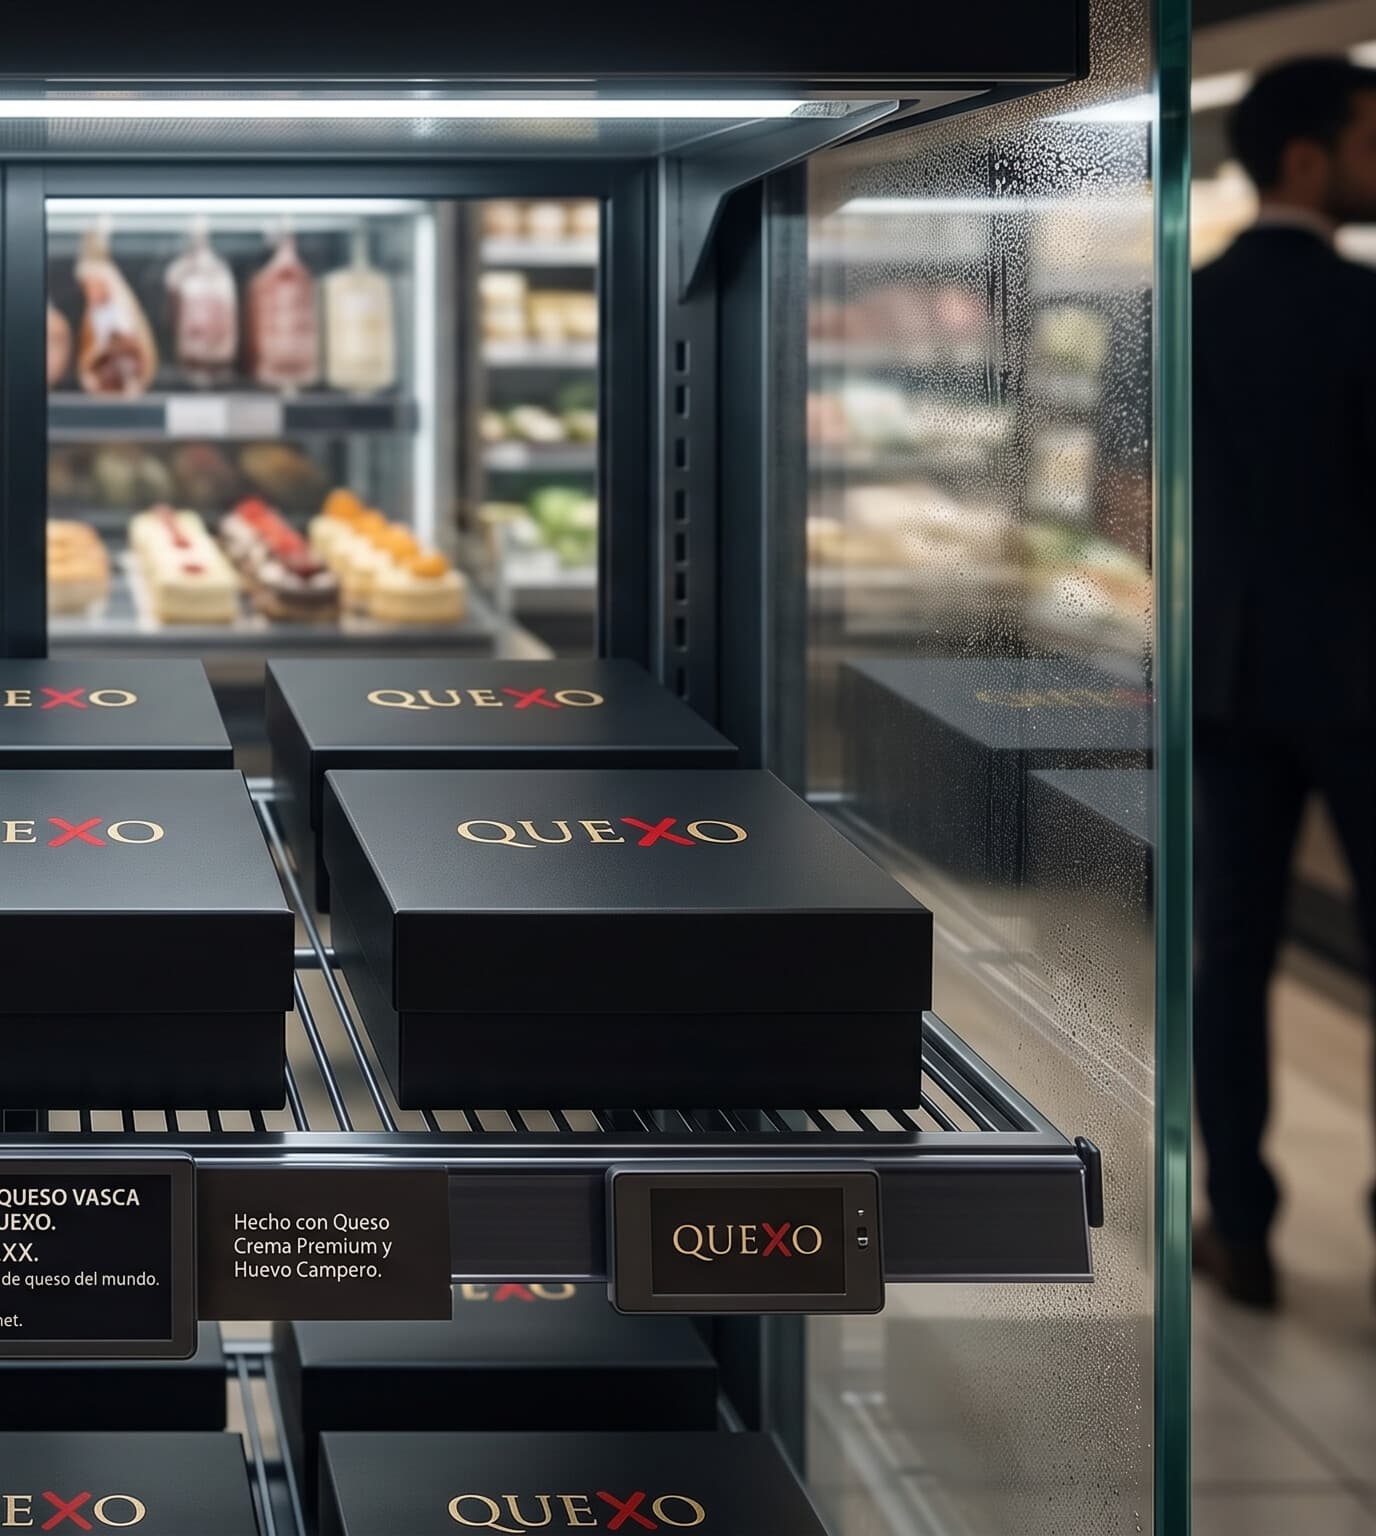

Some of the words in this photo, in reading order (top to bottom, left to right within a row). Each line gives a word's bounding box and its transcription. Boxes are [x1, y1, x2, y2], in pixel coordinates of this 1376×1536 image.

[368, 686, 604, 711] QUEXO
[457, 816, 748, 848] QUEXO
[72, 1188, 139, 1206] VASCA
[234, 1213, 290, 1230] Hecho
[296, 1218, 327, 1230] con
[334, 1214, 389, 1232] Queso
[234, 1238, 291, 1254] Crema
[298, 1238, 376, 1254] Premium
[382, 1242, 392, 1258] y
[672, 1221, 824, 1261] QUEXO
[2, 1272, 20, 1286] de
[25, 1275, 70, 1289] queso
[75, 1272, 97, 1286] del
[103, 1272, 159, 1286] mundo.
[235, 1261, 291, 1277] Huevo
[297, 1261, 381, 1282] Campero.
[447, 1490, 706, 1534] QUEXO
